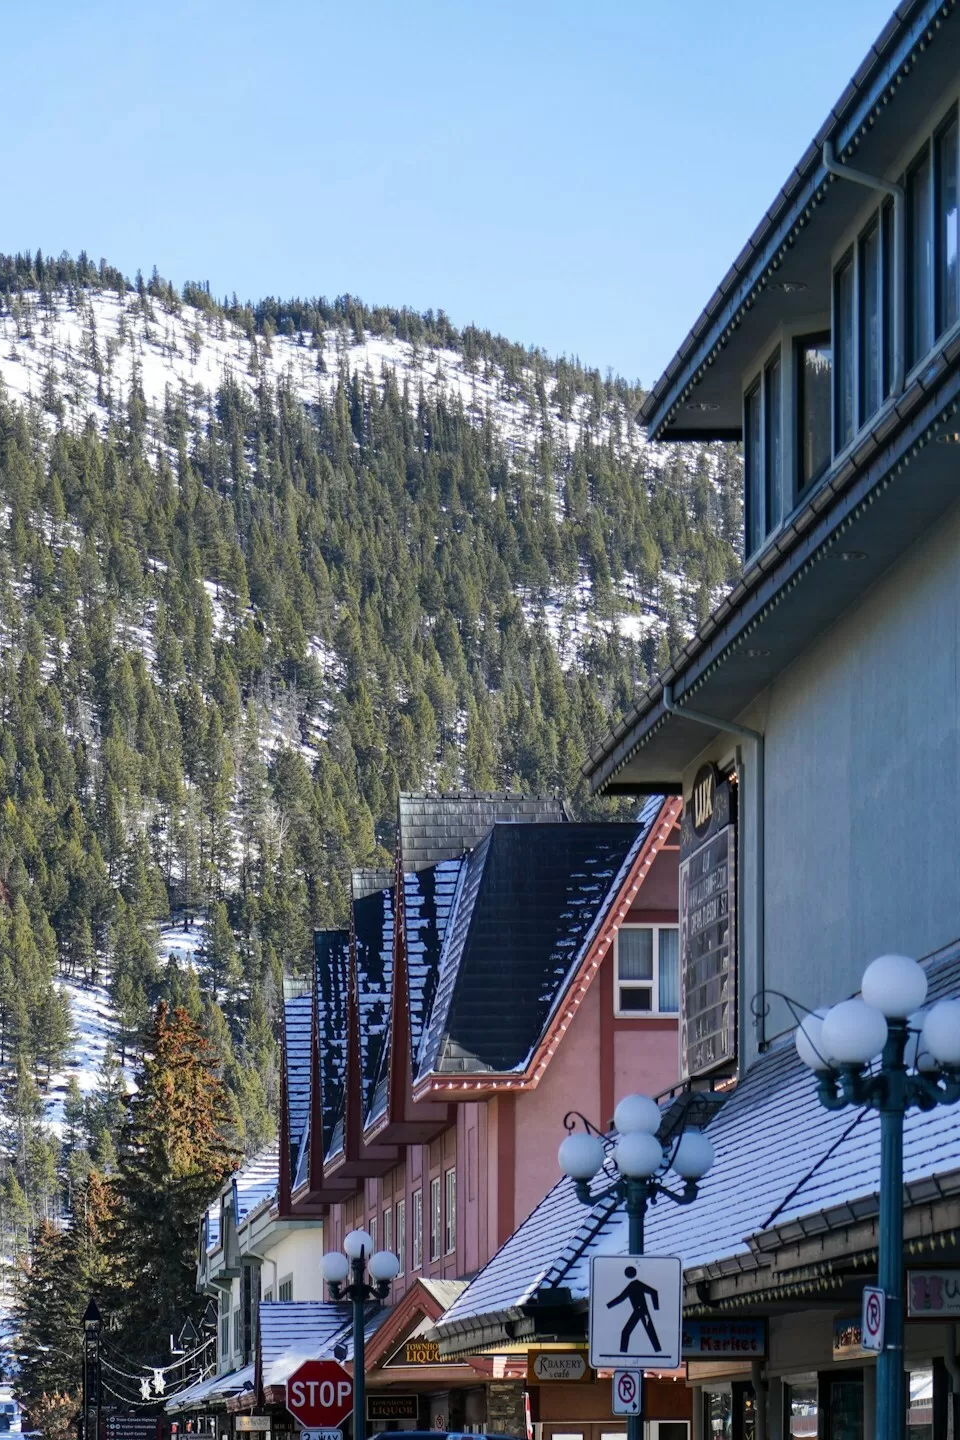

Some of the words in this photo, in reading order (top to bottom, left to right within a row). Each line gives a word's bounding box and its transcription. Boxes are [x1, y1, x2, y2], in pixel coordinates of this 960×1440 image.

[694, 774, 713, 829] LUX
[700, 1336, 757, 1351] Market
[548, 1360, 582, 1368] BAKERY
[553, 1369, 570, 1378] café
[291, 1381, 352, 1407] STOP
[372, 1406, 413, 1416] LIQUOR
